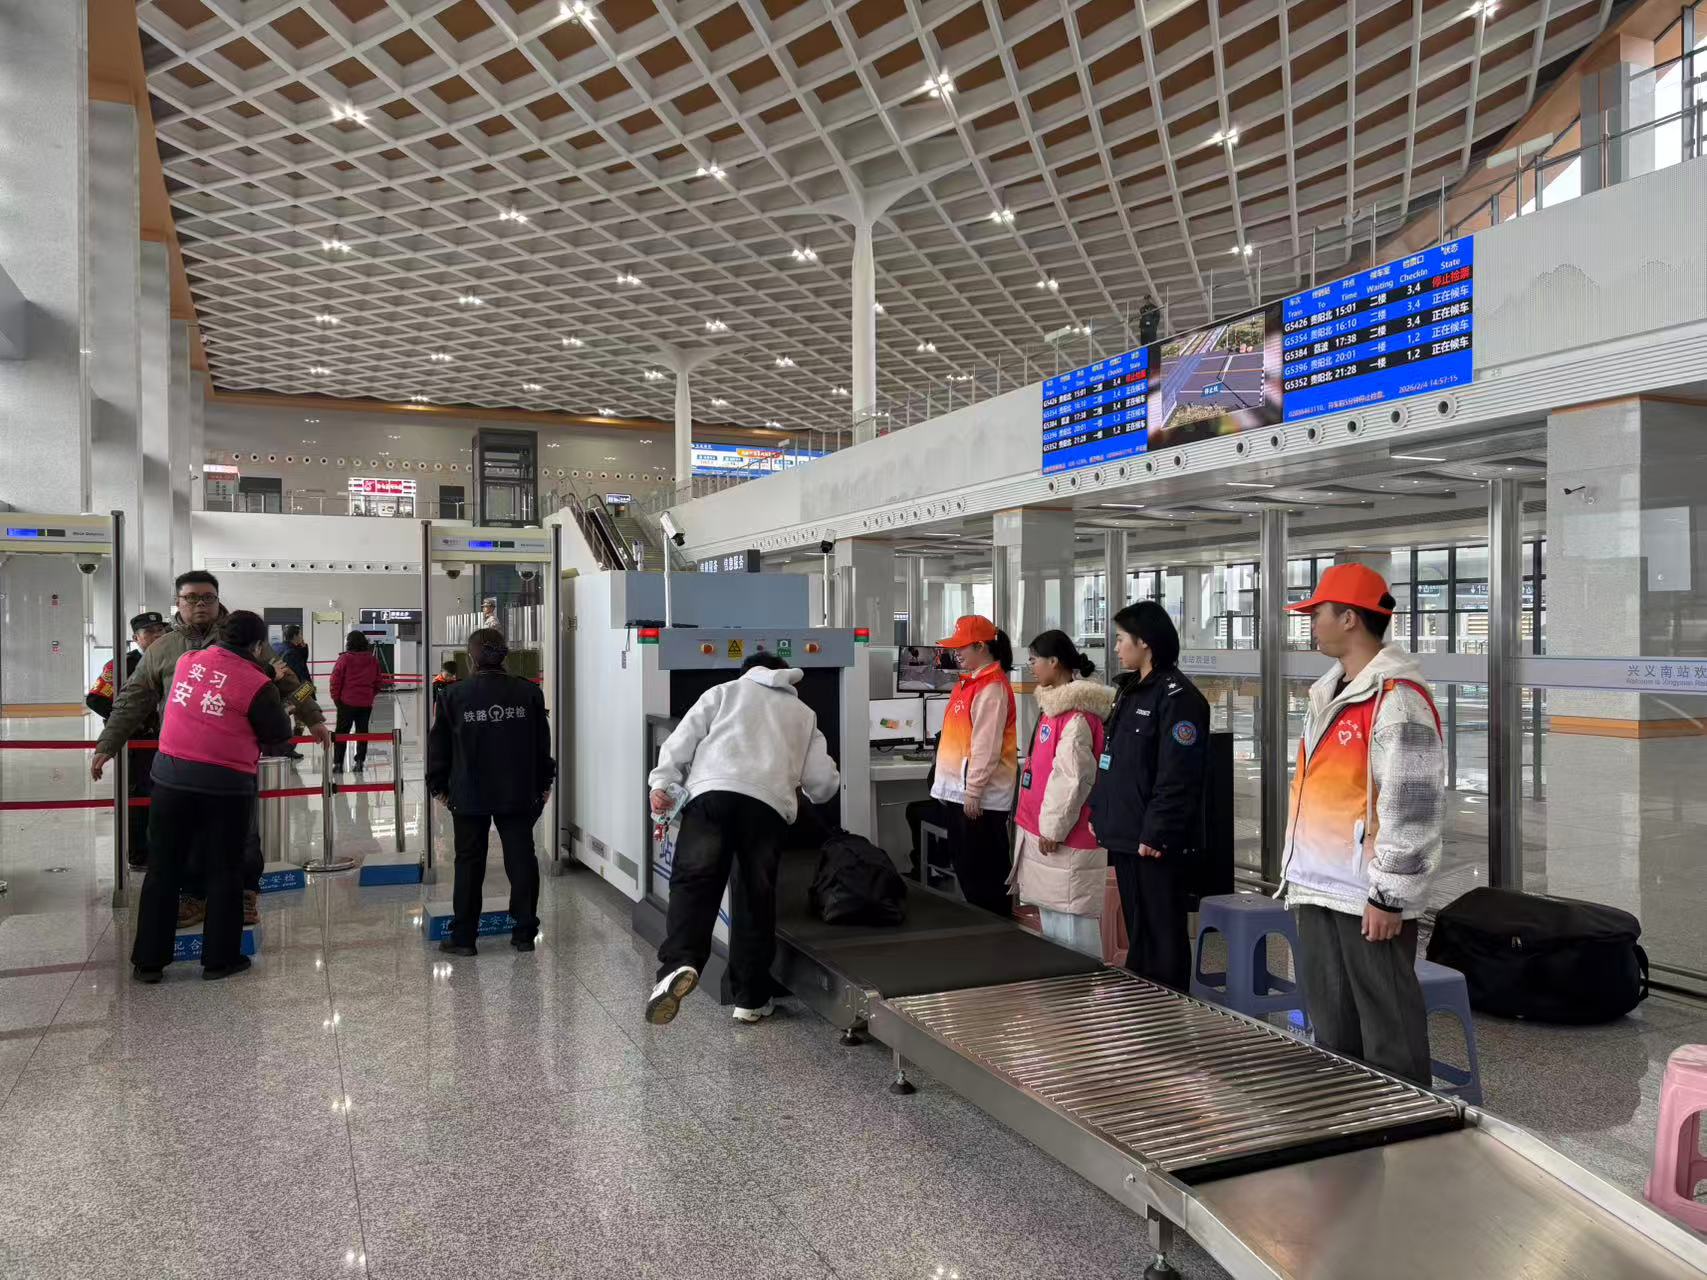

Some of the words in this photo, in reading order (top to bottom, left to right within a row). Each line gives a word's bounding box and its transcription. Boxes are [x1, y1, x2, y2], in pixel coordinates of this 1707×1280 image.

[1285, 317, 1308, 332] G5426
[1335, 302, 1357, 317] 15:01
[1370, 293, 1387, 306] 二楼
[1407, 282, 1421, 295] 3,4
[1432, 266, 1471, 288] 停止检票
[1318, 301, 1326, 309] To
[1366, 279, 1394, 293] Waiting
[1440, 258, 1461, 270] State
[1284, 333, 1308, 347] G5354
[1335, 318, 1357, 331] 16:10
[1370, 309, 1387, 322] 二楼
[1407, 299, 1420, 312] 3,4
[1432, 284, 1469, 305] 正在候车
[1284, 347, 1308, 361] G5384
[1335, 333, 1357, 347] 17:38
[1369, 324, 1387, 338] 二楼
[1407, 315, 1420, 328] 3,4
[1432, 301, 1470, 322] 正在候车
[1284, 363, 1308, 376] G5396
[1335, 349, 1356, 363] 20:01
[1369, 341, 1387, 353] 一楼
[1407, 332, 1421, 344] 1,2
[1431, 319, 1469, 339] 正在候车
[1284, 377, 1308, 390] G5352
[1335, 364, 1357, 378] 21:28
[1369, 357, 1387, 370] 一楼
[1407, 348, 1421, 361] 1,2
[1431, 336, 1469, 356] 正在候车
[724, 555, 744, 571] 信息服务
[172, 681, 226, 717] 安检
[188, 663, 228, 689] 实习
[463, 709, 488, 722] 铁路
[504, 706, 527, 719] 安检
